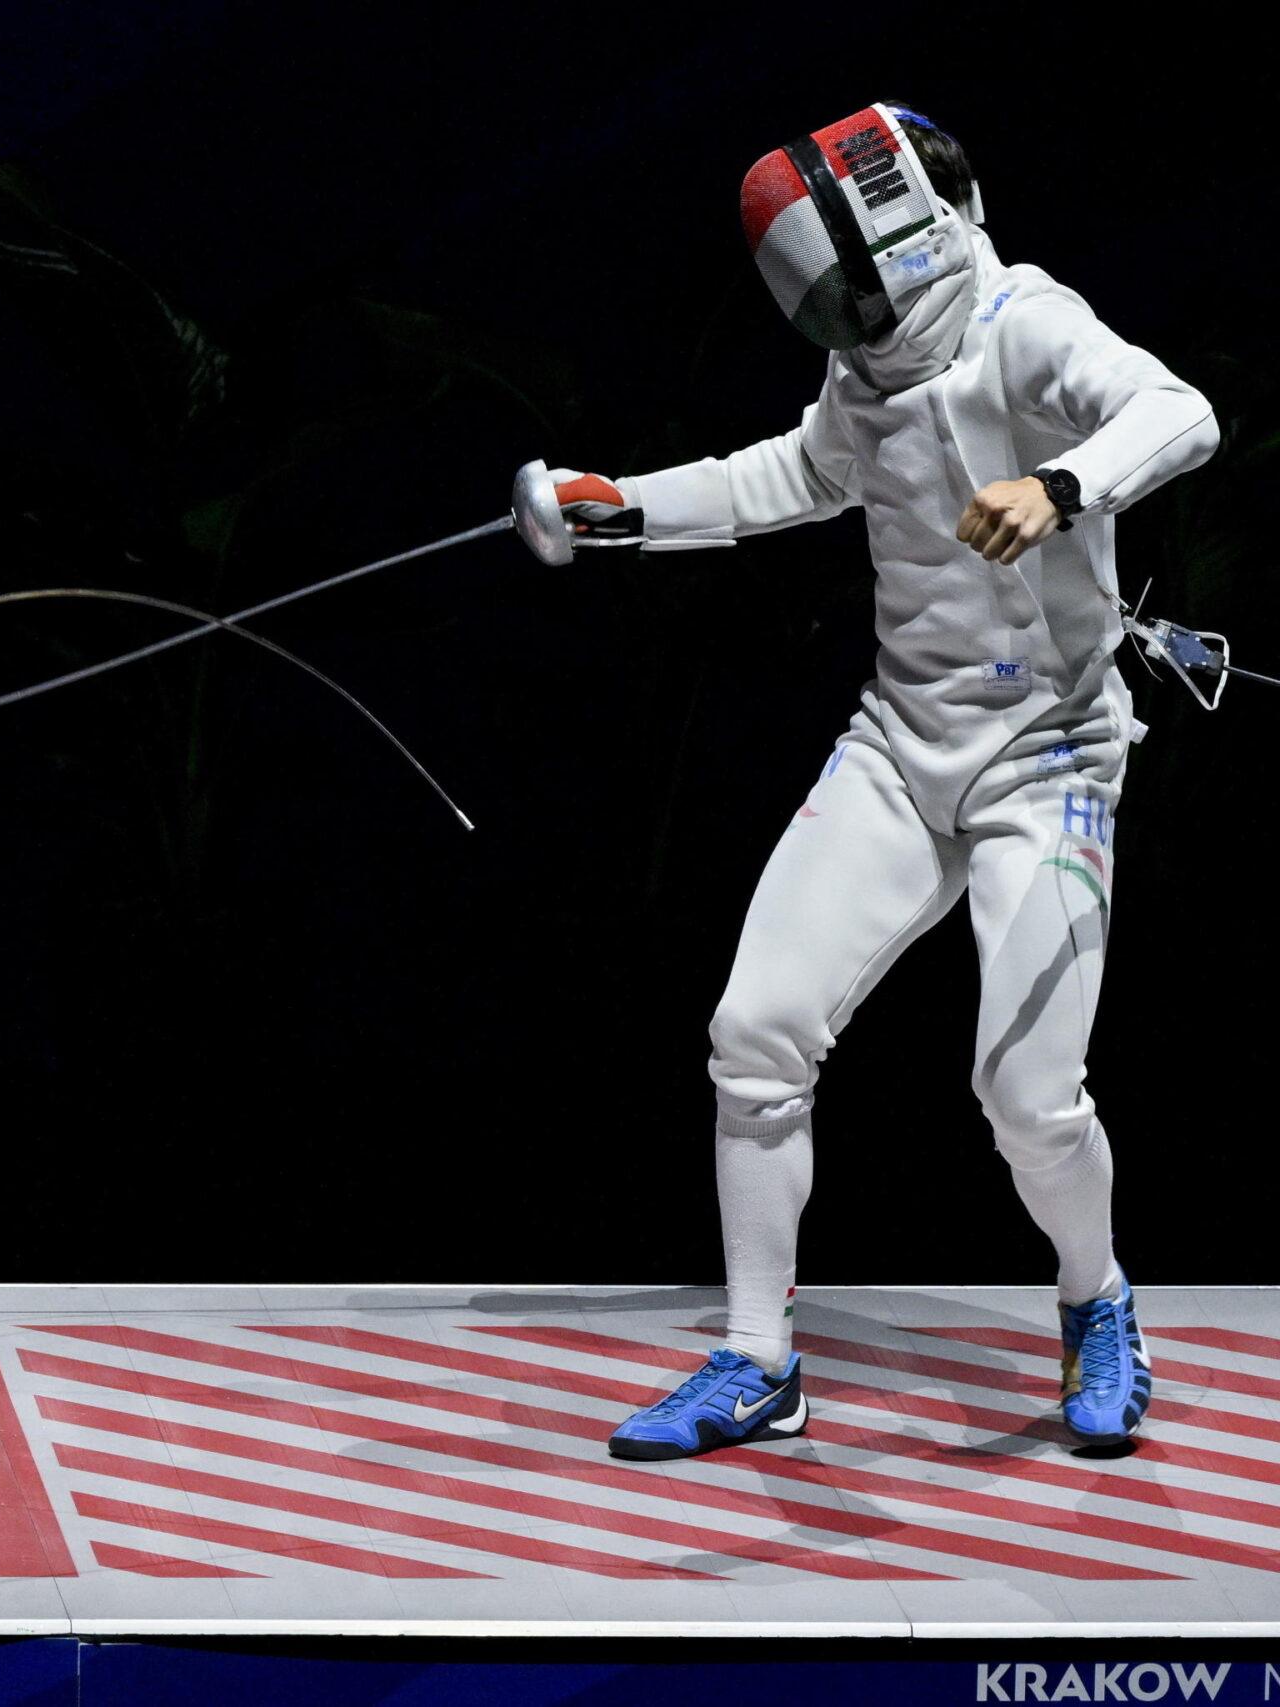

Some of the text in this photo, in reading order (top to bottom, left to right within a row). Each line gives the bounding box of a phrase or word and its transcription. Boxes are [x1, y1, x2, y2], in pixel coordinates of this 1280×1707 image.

[835, 127, 910, 211] HUN
[995, 663, 1020, 677] PBT
[1063, 791, 1112, 848] HU
[976, 1662, 1232, 1701] KRAKOW
